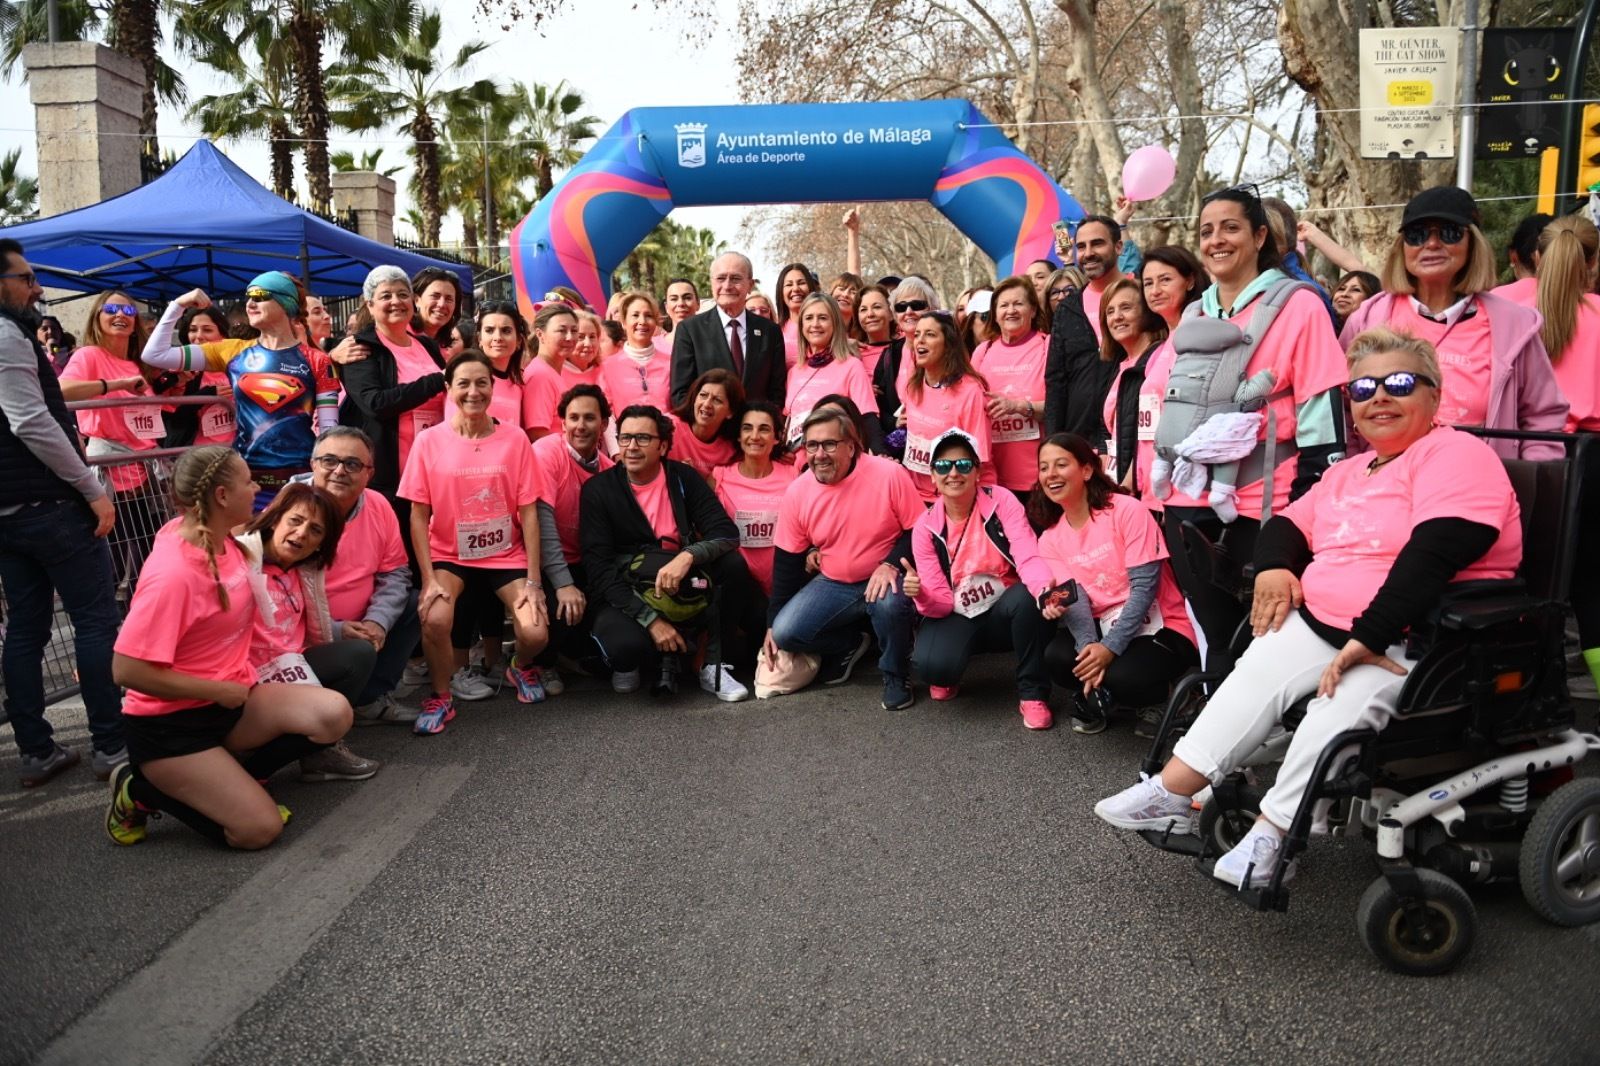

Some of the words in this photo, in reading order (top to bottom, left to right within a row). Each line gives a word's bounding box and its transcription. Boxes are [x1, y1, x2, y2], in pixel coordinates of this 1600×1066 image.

[1376, 50, 1393, 61] THE
[1397, 50, 1414, 60] CAT
[1418, 49, 1446, 60] SHOW
[1411, 66, 1437, 74] CALLEJA
[716, 131, 837, 151] Ayuntamiento
[843, 129, 864, 144] de
[869, 127, 932, 146] Málaga
[717, 152, 743, 164] Área
[745, 152, 759, 163] de
[761, 152, 806, 165] Deporte
[134, 416, 154, 430] 1115
[991, 417, 1035, 433] 4501
[744, 523, 774, 537] 1097
[467, 528, 504, 549] 2633
[960, 581, 995, 607] 3314
[263, 665, 308, 684] 358
